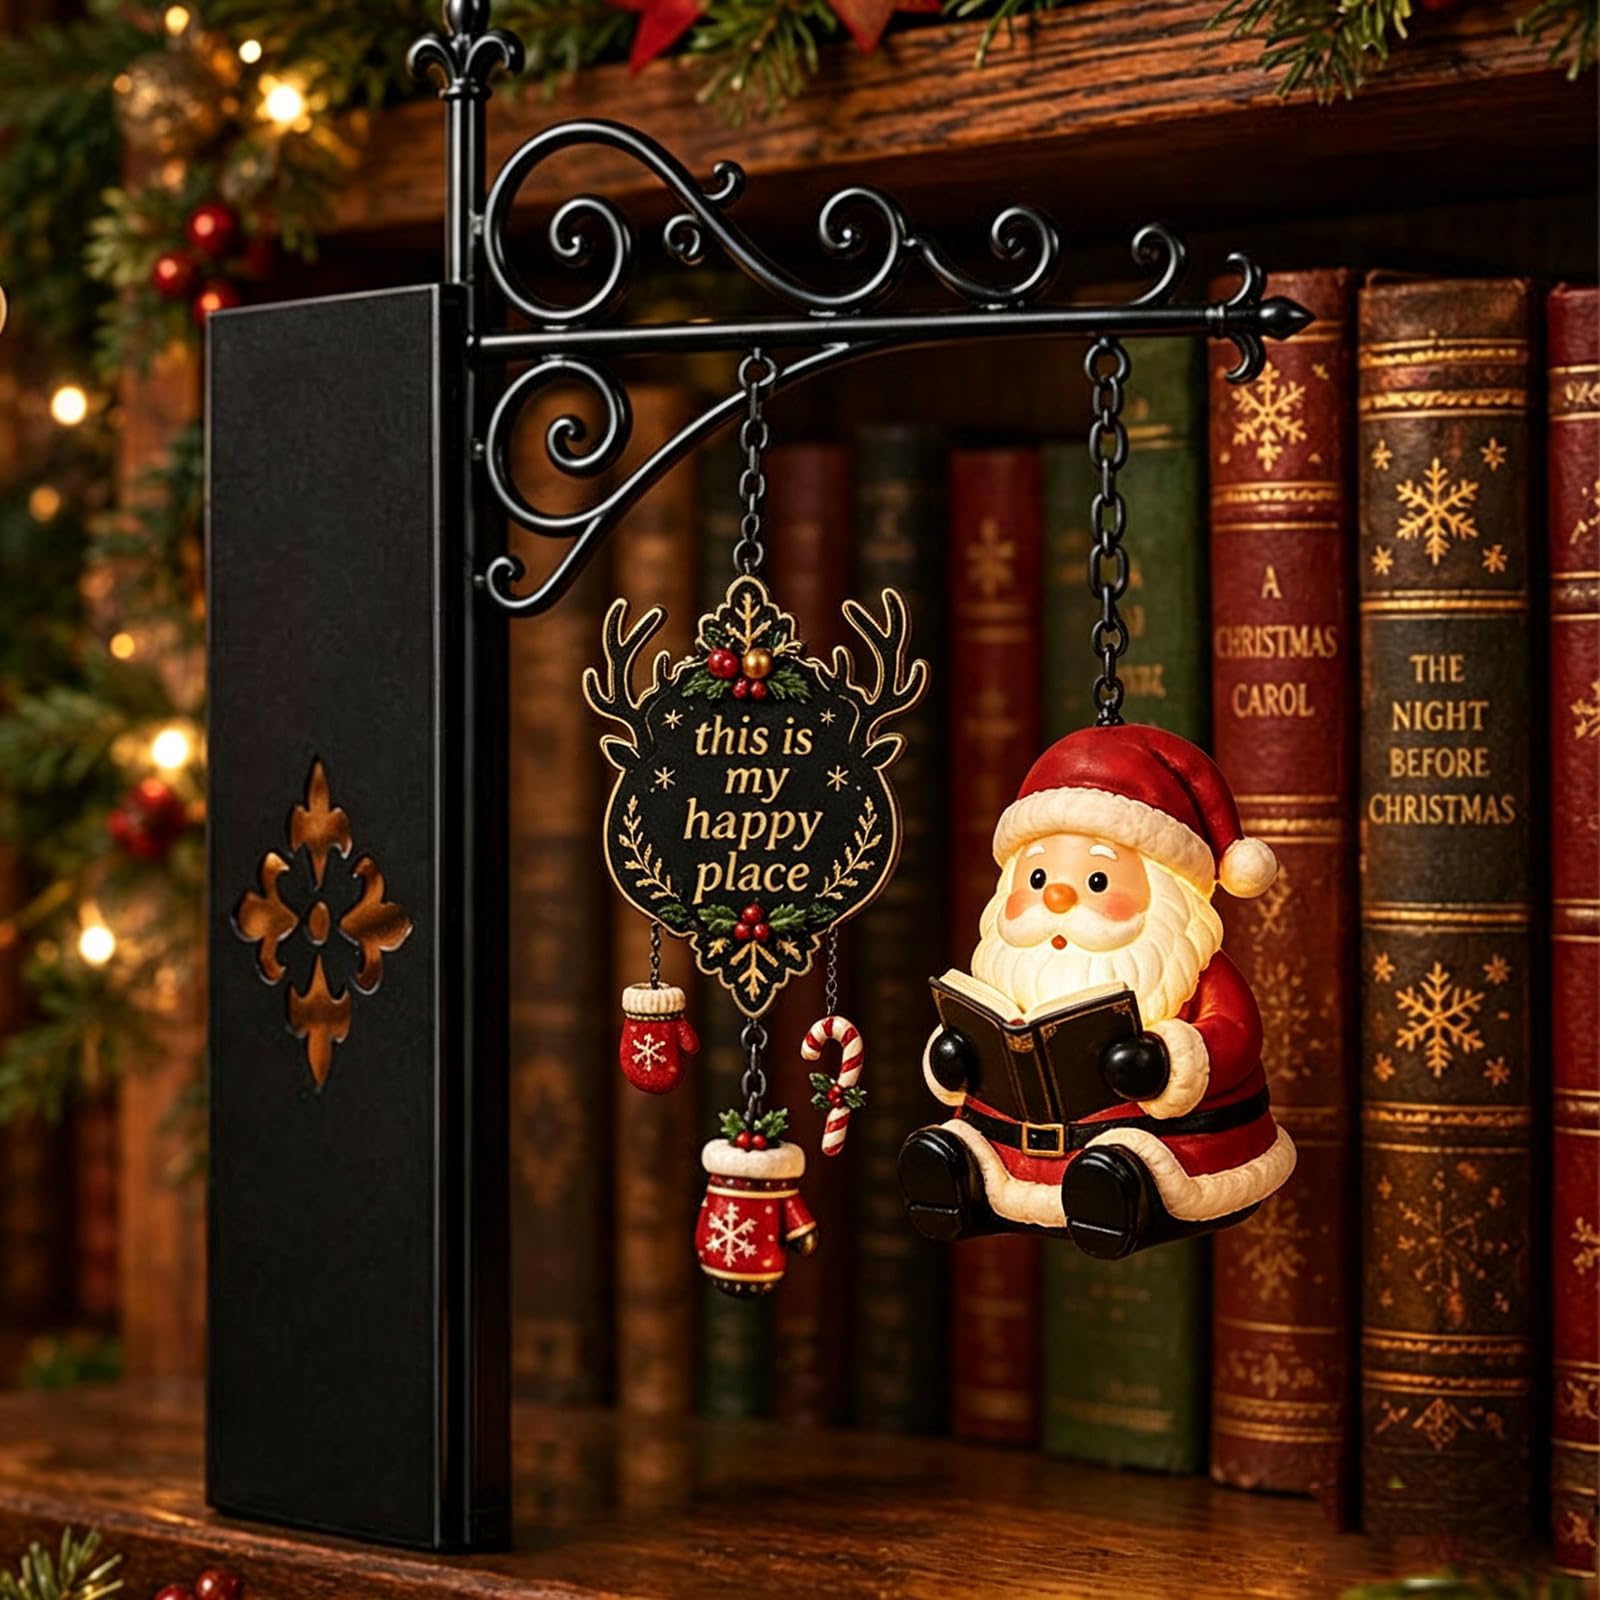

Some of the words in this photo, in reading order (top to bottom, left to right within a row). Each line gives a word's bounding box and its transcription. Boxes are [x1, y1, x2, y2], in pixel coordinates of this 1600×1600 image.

[1261, 565, 1282, 599] A
[1214, 625, 1338, 659] CHRISTMAS
[1410, 654, 1465, 683] THE
[1232, 682, 1315, 717] CAROL
[1391, 701, 1489, 731] NIGHT
[695, 714, 769, 756] this
[782, 716, 814, 756] is
[1390, 747, 1491, 778] BEFORE
[724, 767, 791, 803] my
[683, 797, 824, 851] happy
[1368, 793, 1516, 825] CHRISTMAS
[692, 851, 810, 905] place
